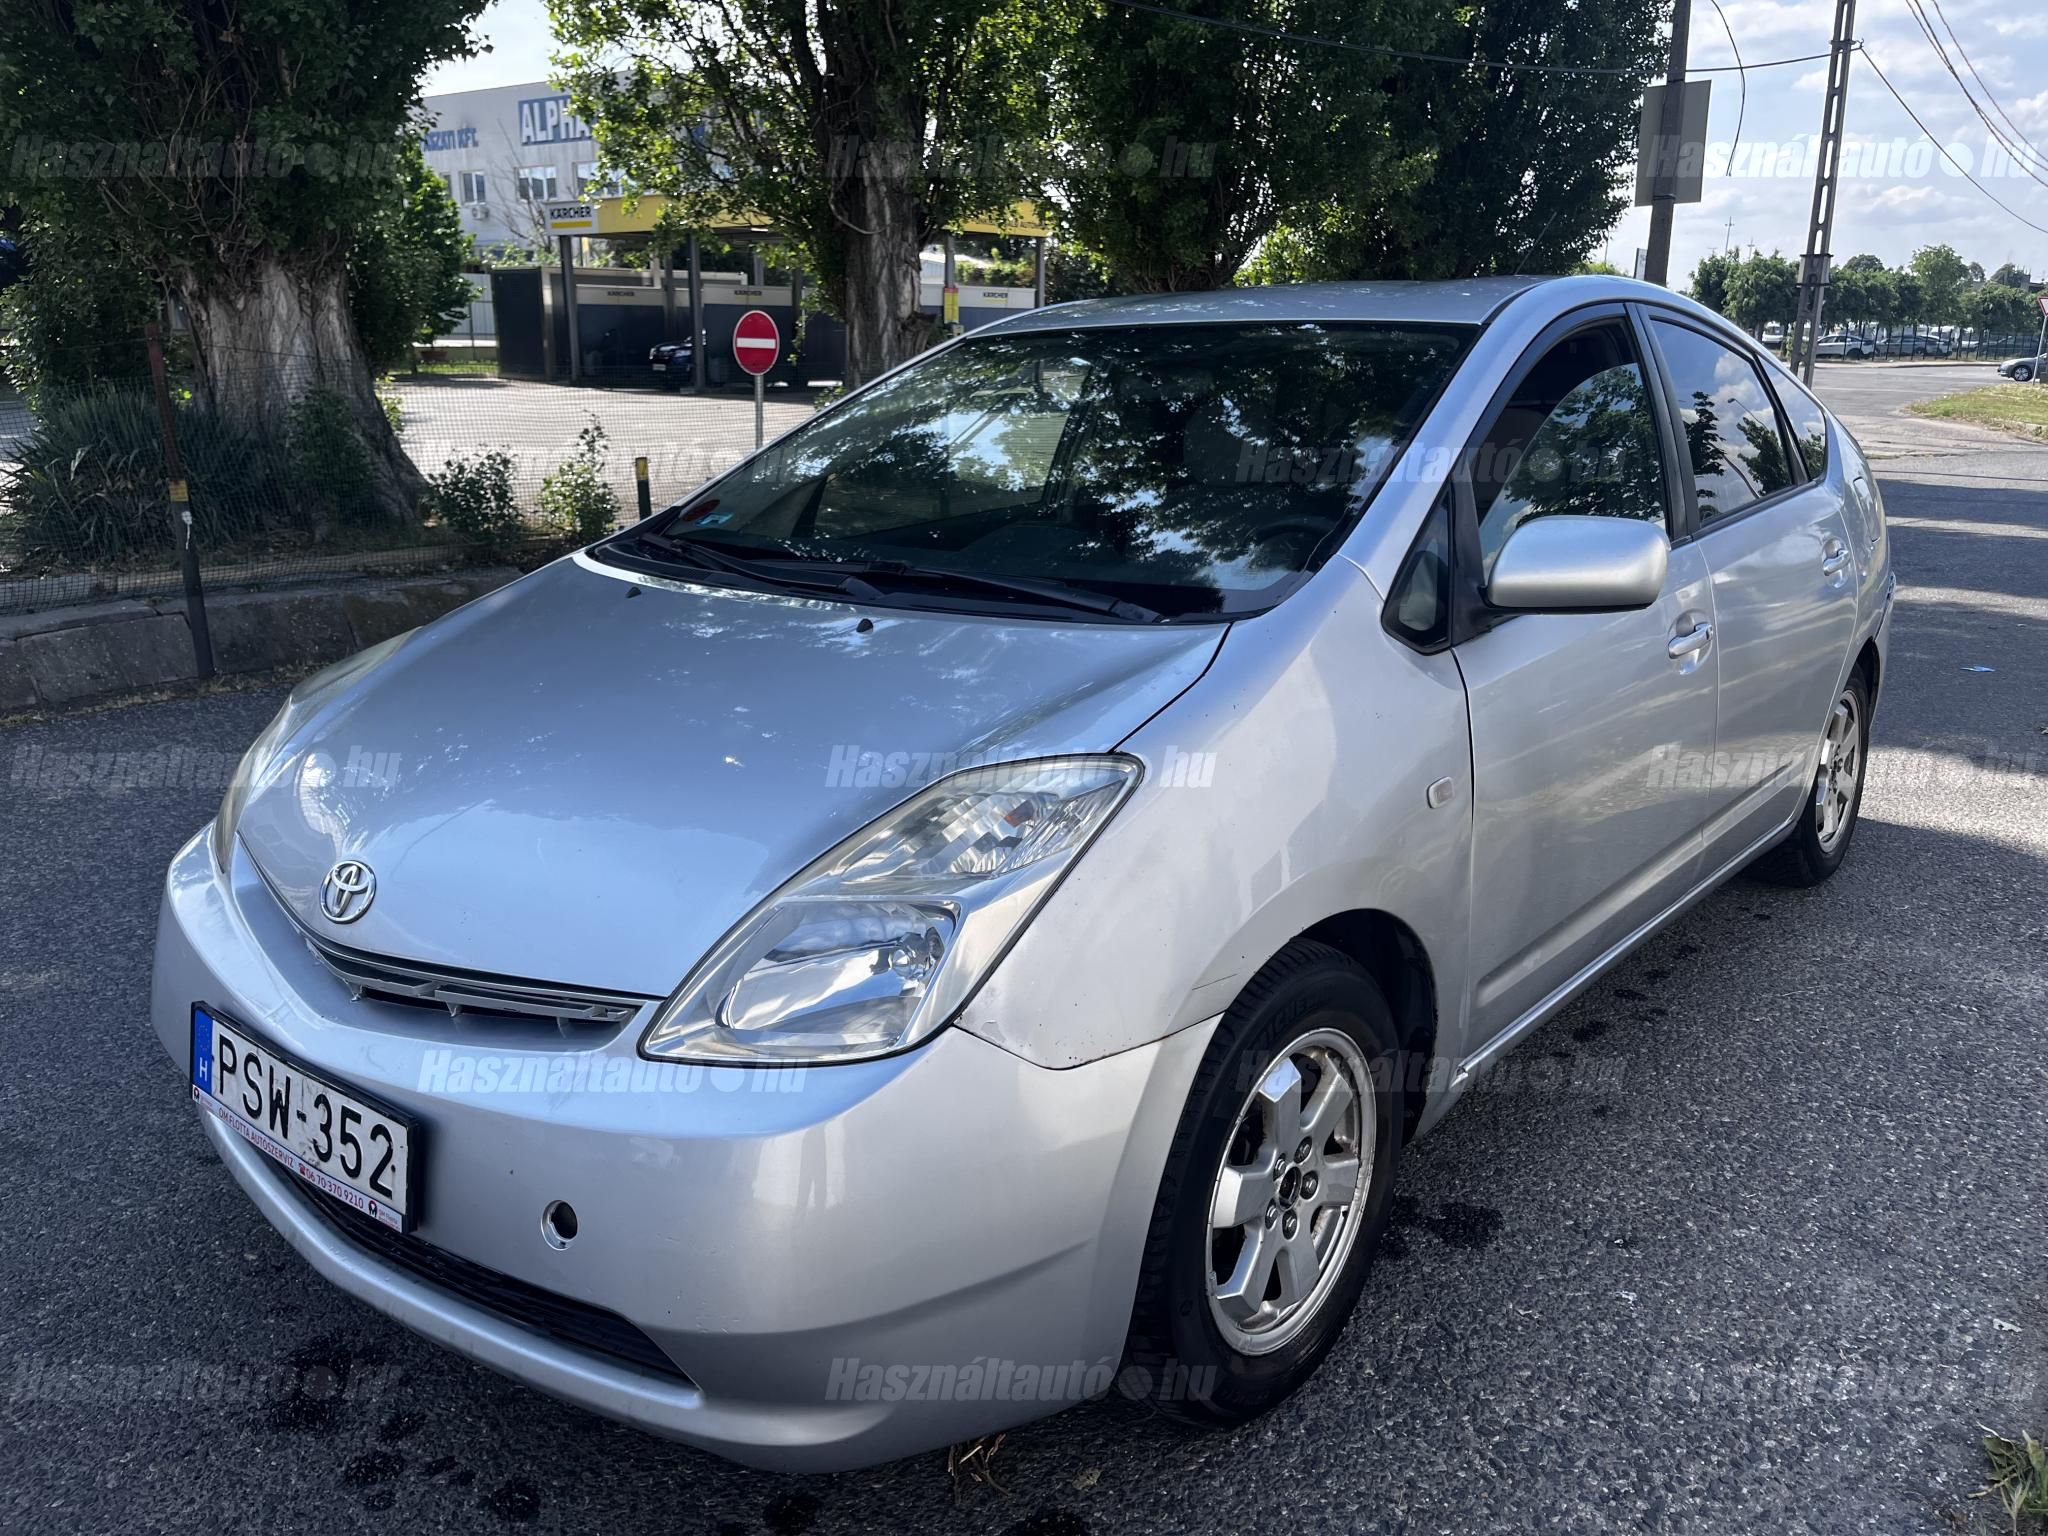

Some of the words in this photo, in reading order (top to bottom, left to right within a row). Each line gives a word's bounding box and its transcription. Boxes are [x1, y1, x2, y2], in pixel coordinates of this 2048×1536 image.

[199, 1057, 208, 1082] H
[219, 1033, 393, 1200] PSW-352
[306, 1168, 315, 1182] 06
[327, 1180, 342, 1197] 370
[344, 1190, 363, 1208] 9210
